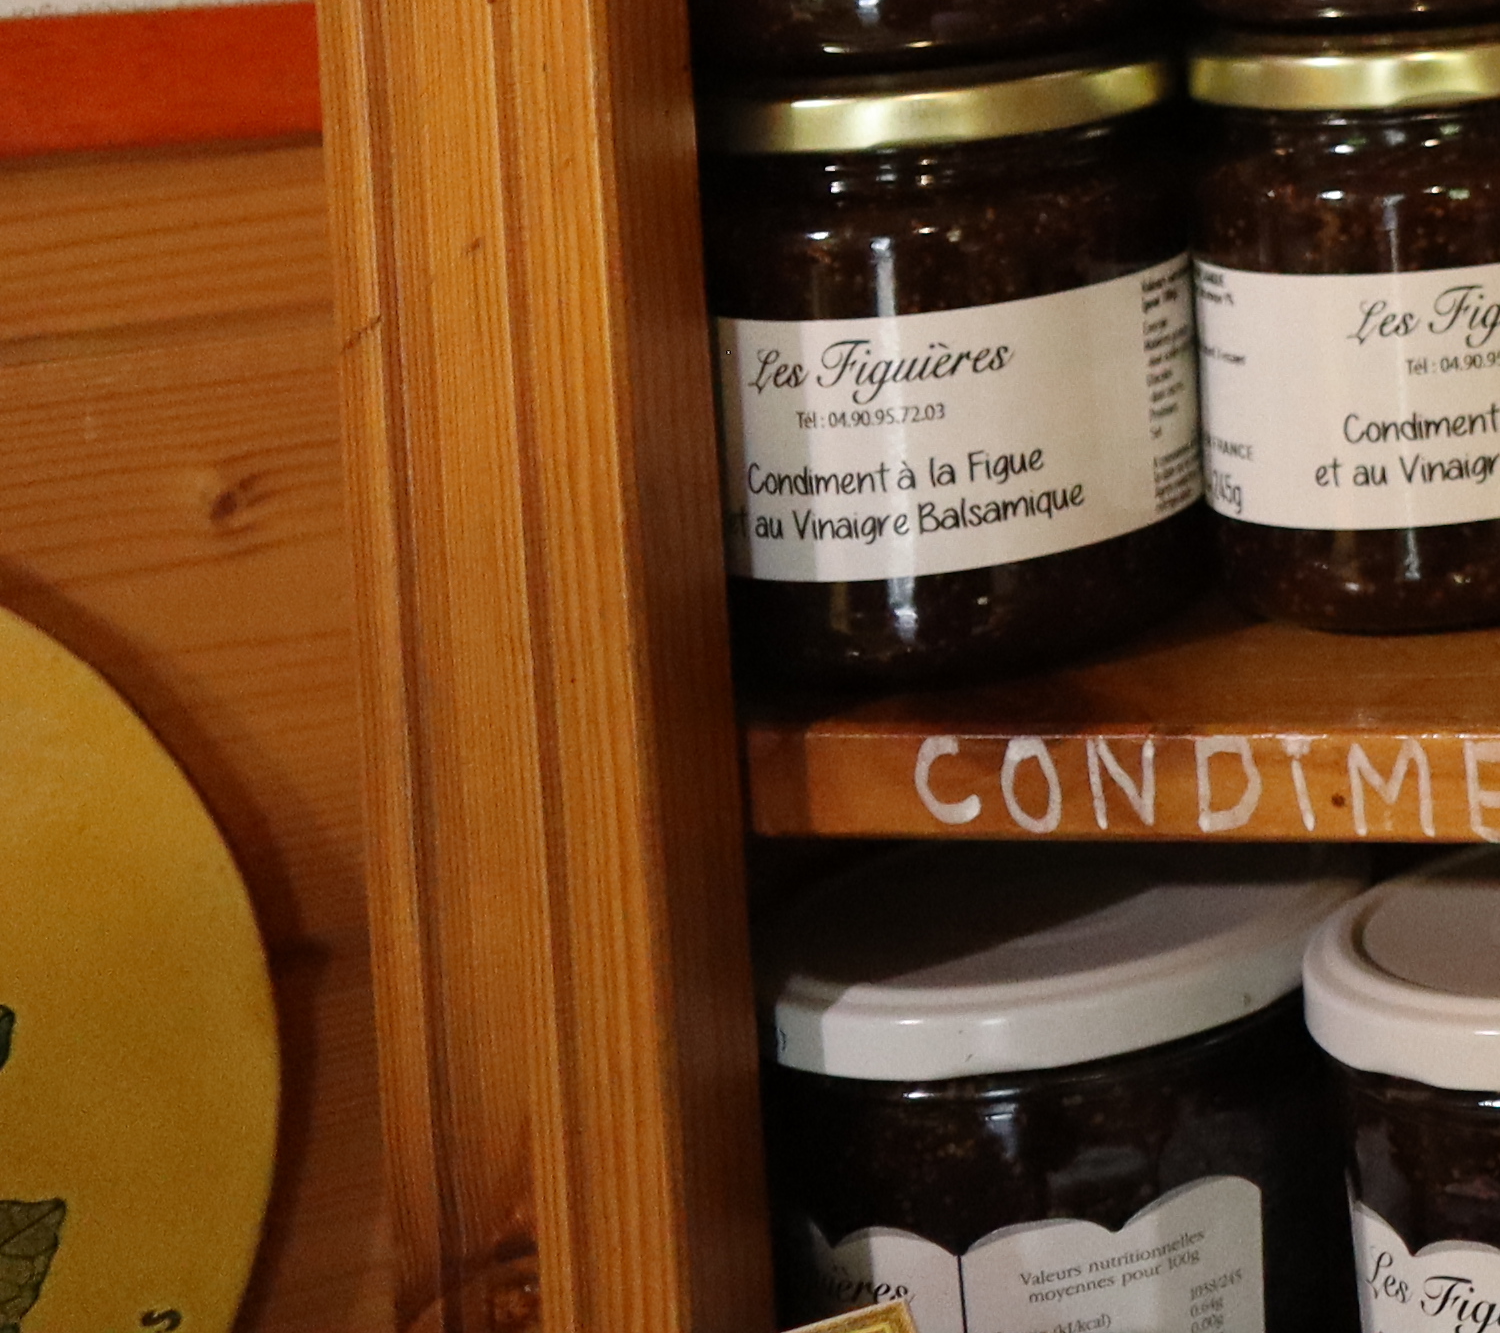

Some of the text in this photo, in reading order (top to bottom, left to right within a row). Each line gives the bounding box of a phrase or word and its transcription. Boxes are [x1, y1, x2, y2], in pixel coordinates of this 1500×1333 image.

[1348, 300, 1421, 345] Les
[1020, 1264, 1081, 1286] Valeurs
[1029, 1277, 1115, 1304] moyennes
[1121, 1261, 1162, 1286] pour
[1366, 1248, 1411, 1303] Les
